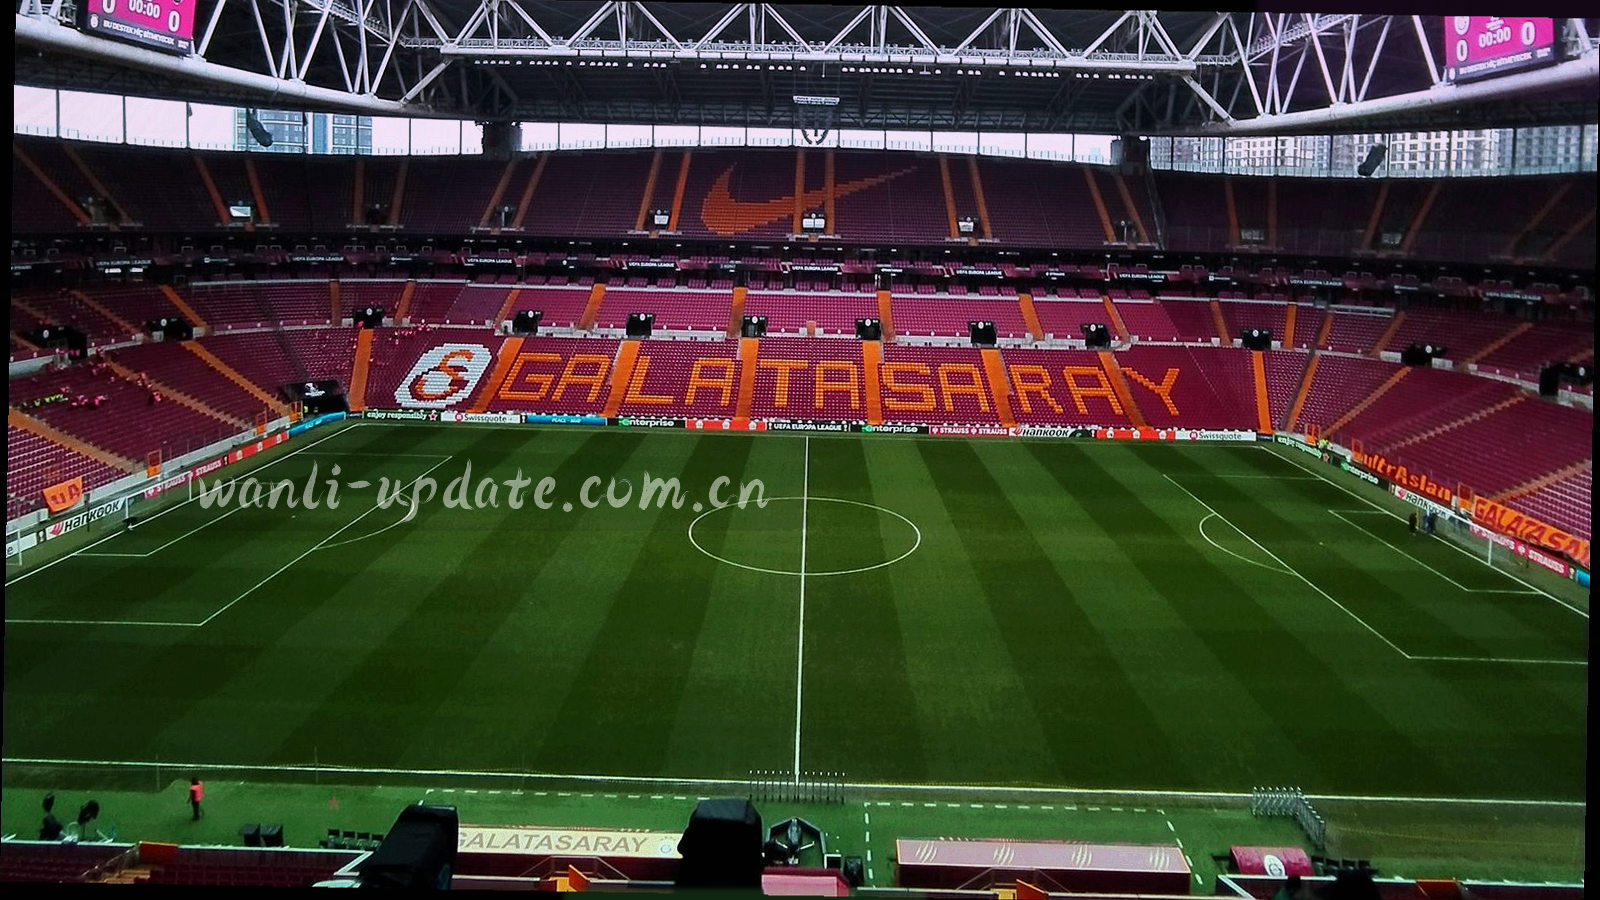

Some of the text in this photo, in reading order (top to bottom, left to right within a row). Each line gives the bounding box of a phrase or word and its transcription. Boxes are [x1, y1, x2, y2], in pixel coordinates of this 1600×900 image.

[129, 0, 160, 18] 00:00
[168, 10, 180, 32] 0
[1478, 26, 1511, 48] 00:00
[1522, 22, 1535, 45] 0
[1456, 40, 1468, 62] 0
[498, 352, 1180, 416] GALATASARAY
[367, 412, 427, 422] enjoy responsibly
[464, 413, 507, 424] Swissquote
[620, 418, 674, 428] enterprise
[864, 425, 918, 434] enterprise
[978, 427, 1007, 435] STRAUSS
[1198, 432, 1242, 440] Swissquote
[196, 460, 222, 476] STRAUSS
[1364, 454, 1451, 502] ultrAslan
[1528, 550, 1564, 573] STRAUSS
